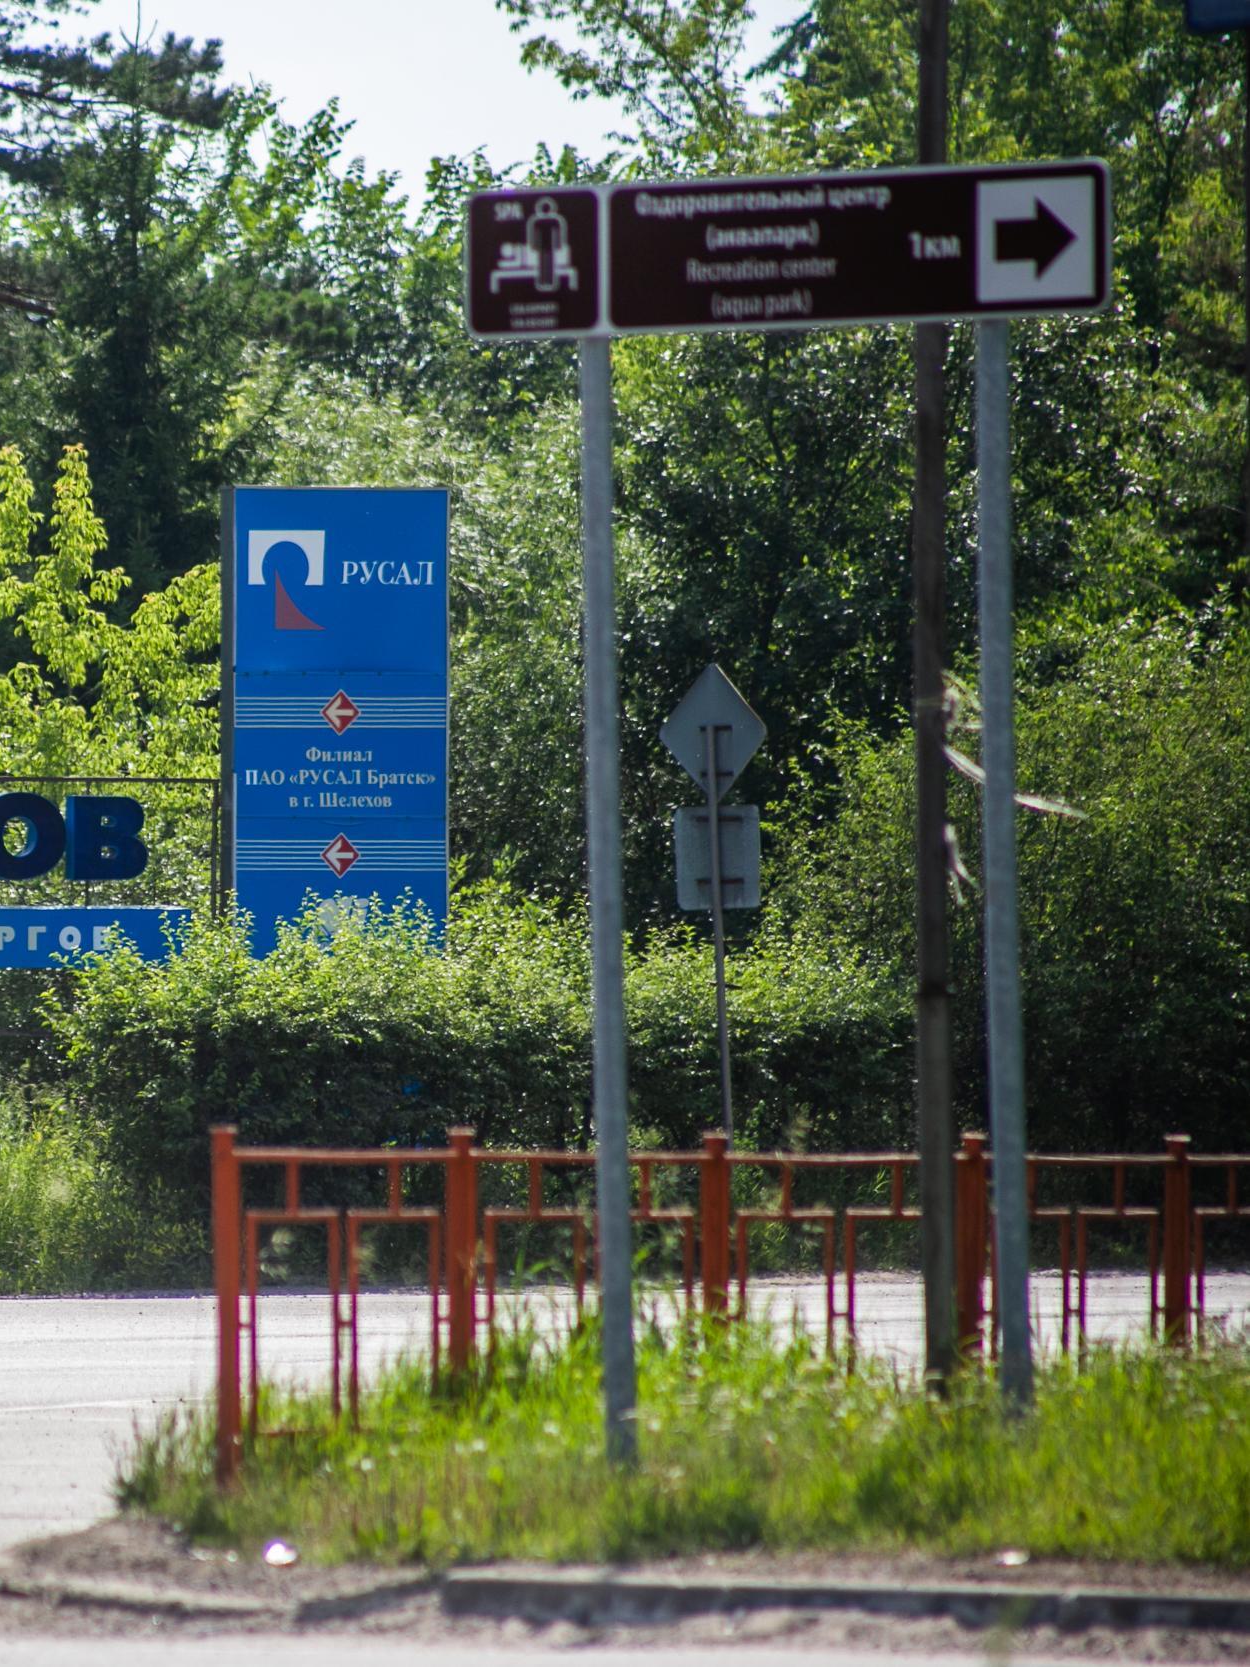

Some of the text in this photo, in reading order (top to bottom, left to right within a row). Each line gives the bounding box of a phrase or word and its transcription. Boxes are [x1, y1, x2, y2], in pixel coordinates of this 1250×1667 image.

[494, 202, 523, 221] SPA
[686, 257, 837, 282] Recreation center
[711, 289, 813, 320] (aqua park)
[340, 561, 434, 586] РУСАЛ
[305, 746, 373, 763] Филиал
[245, 769, 436, 789] ПАО «РУСАЛ Братск»
[289, 792, 393, 808] в г. Шелехов
